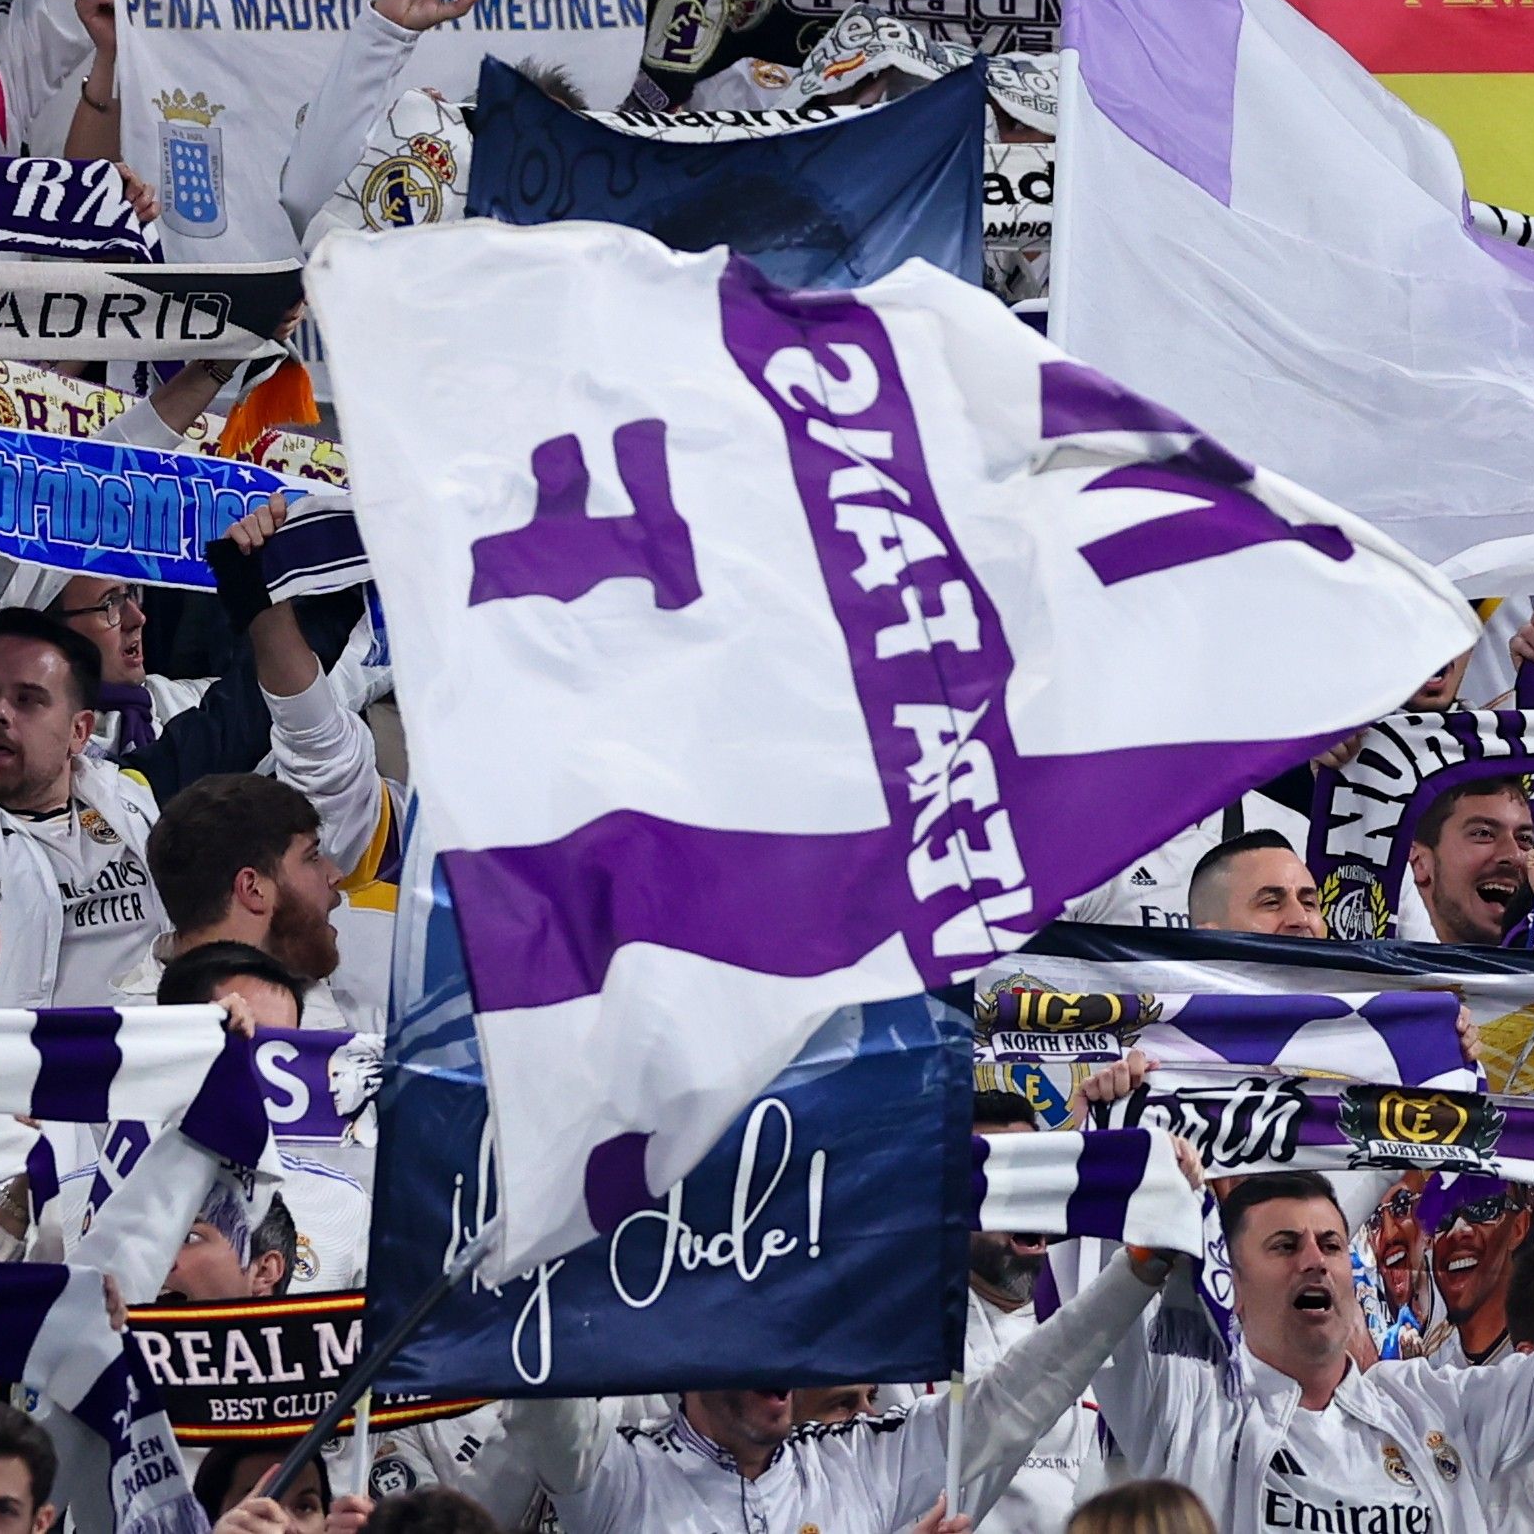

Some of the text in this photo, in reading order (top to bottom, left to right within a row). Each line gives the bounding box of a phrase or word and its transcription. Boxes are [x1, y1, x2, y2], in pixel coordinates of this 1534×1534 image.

[74, 891, 146, 927] BETTER
[999, 1032, 1109, 1053] NORTH FANS
[133, 1326, 306, 1384] REAL
[209, 1396, 265, 1423] BEST
[1266, 1491, 1431, 1534] Emirates
